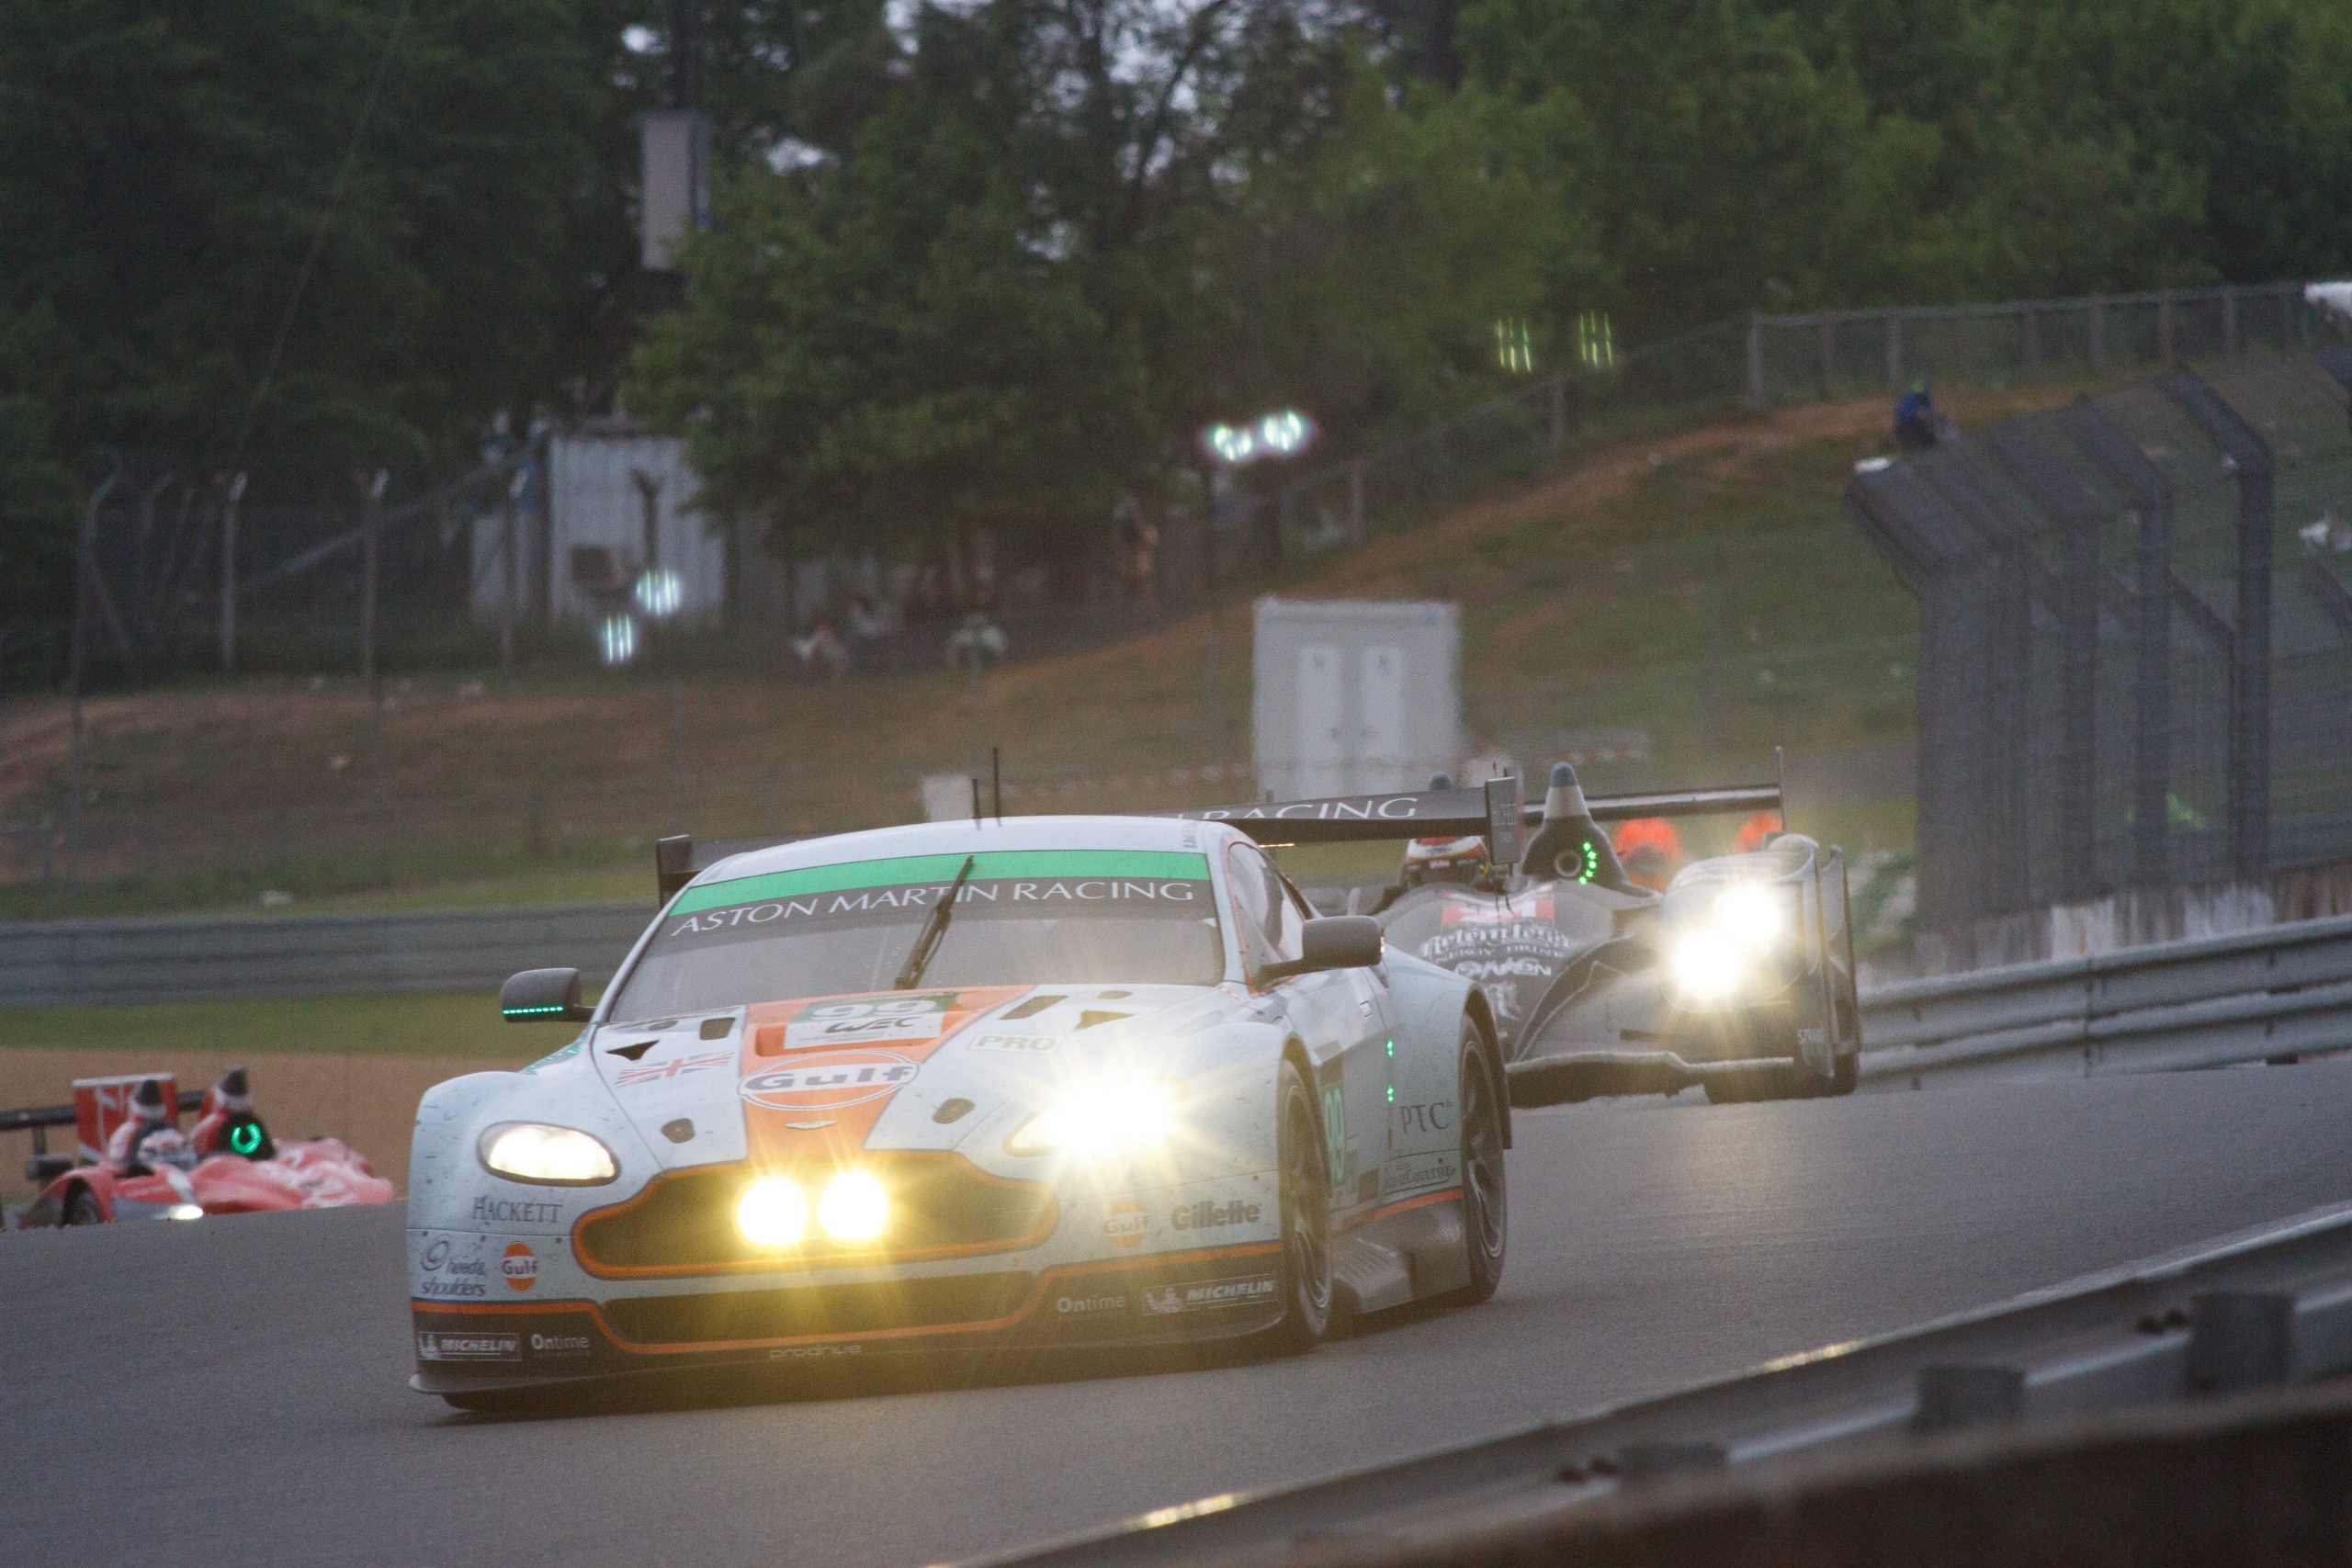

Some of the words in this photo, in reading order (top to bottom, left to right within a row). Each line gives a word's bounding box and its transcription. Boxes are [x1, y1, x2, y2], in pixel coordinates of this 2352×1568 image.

[671, 898, 819, 936] ASTON
[828, 884, 998, 913] MARTIN
[1012, 882, 1193, 901] RACING
[811, 999, 937, 1021] 99
[824, 1016, 922, 1033] WEC
[976, 1035, 1056, 1051] PRO
[745, 1066, 913, 1092] Gulf
[1400, 1101, 1449, 1134] PTC
[472, 1197, 563, 1224] HACKETT
[1170, 1200, 1261, 1231] Gillette
[1105, 1214, 1148, 1235] Gulf
[502, 1259, 538, 1276] Gulf
[422, 1277, 485, 1297] shoulders
[1186, 1280, 1275, 1302] MICHELIN
[1057, 1293, 1125, 1314] Ontime
[439, 1338, 517, 1352] MICHELIN
[530, 1333, 590, 1350] Ontime
